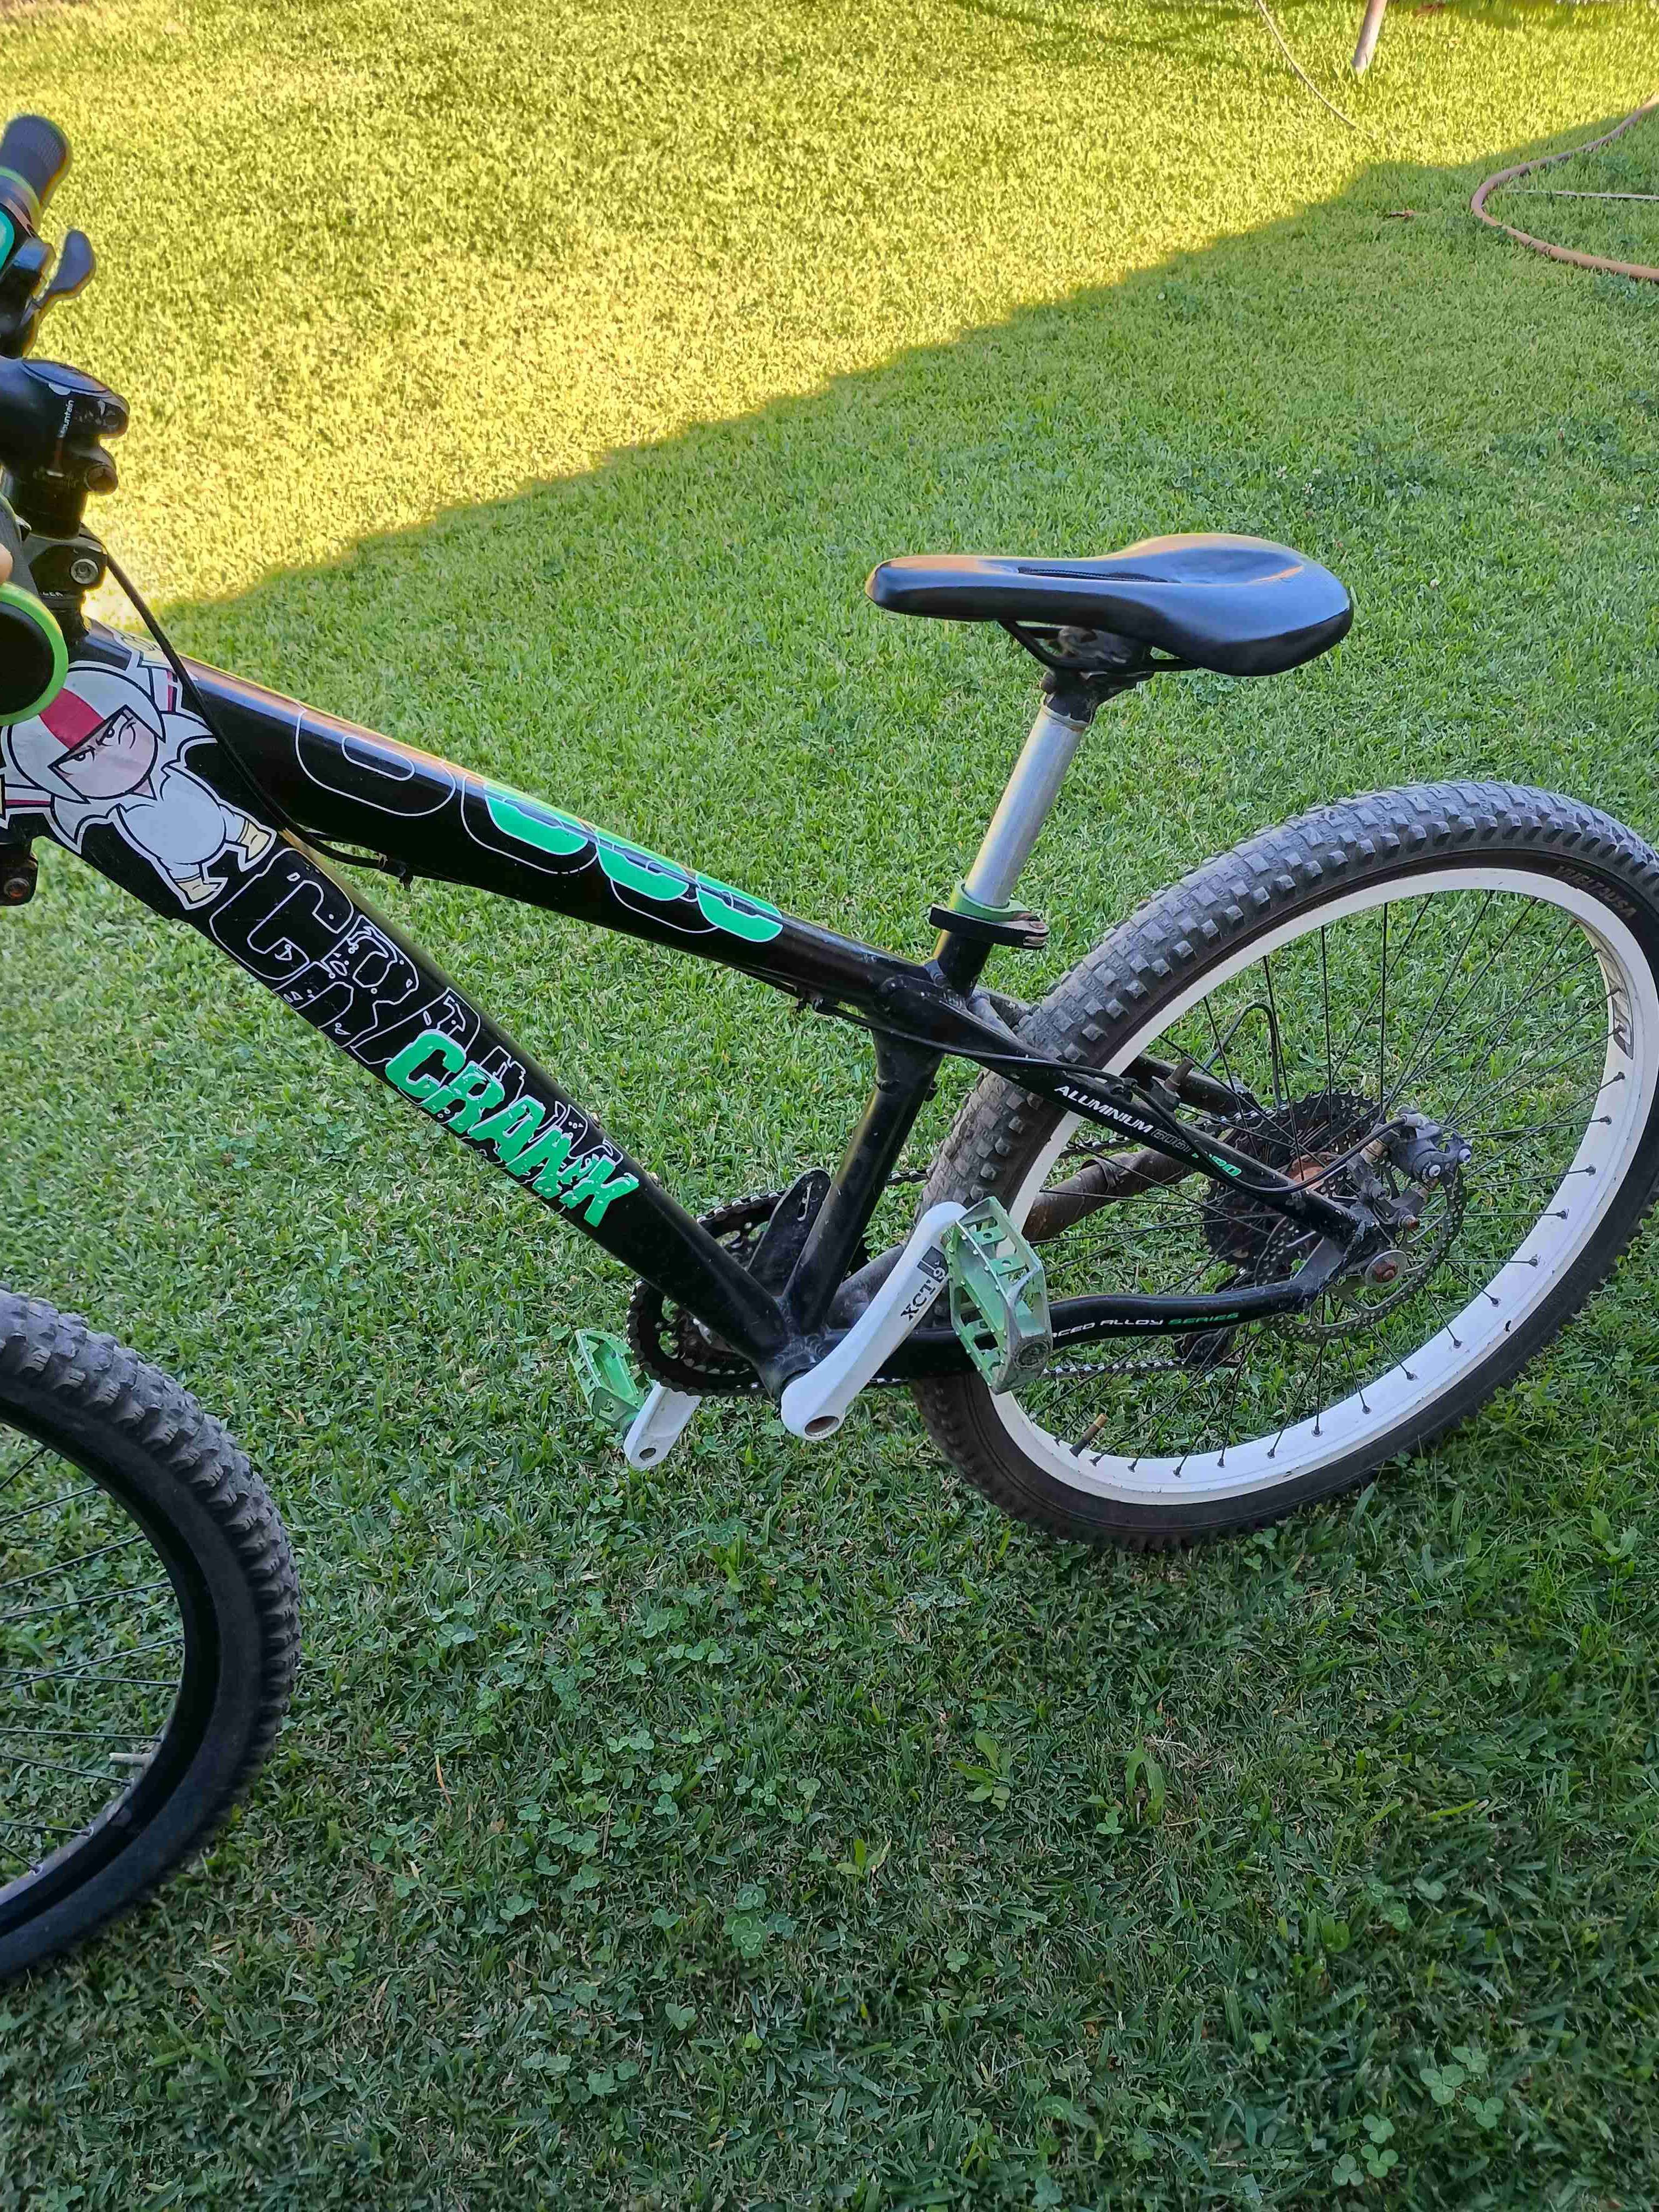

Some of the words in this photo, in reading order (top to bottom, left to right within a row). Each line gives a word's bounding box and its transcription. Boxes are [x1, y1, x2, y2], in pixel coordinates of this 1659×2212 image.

[384, 1028, 640, 1227] CRANK
[1054, 1085, 1154, 1134] ALUMINIUM
[901, 1279, 936, 1321] XCT
